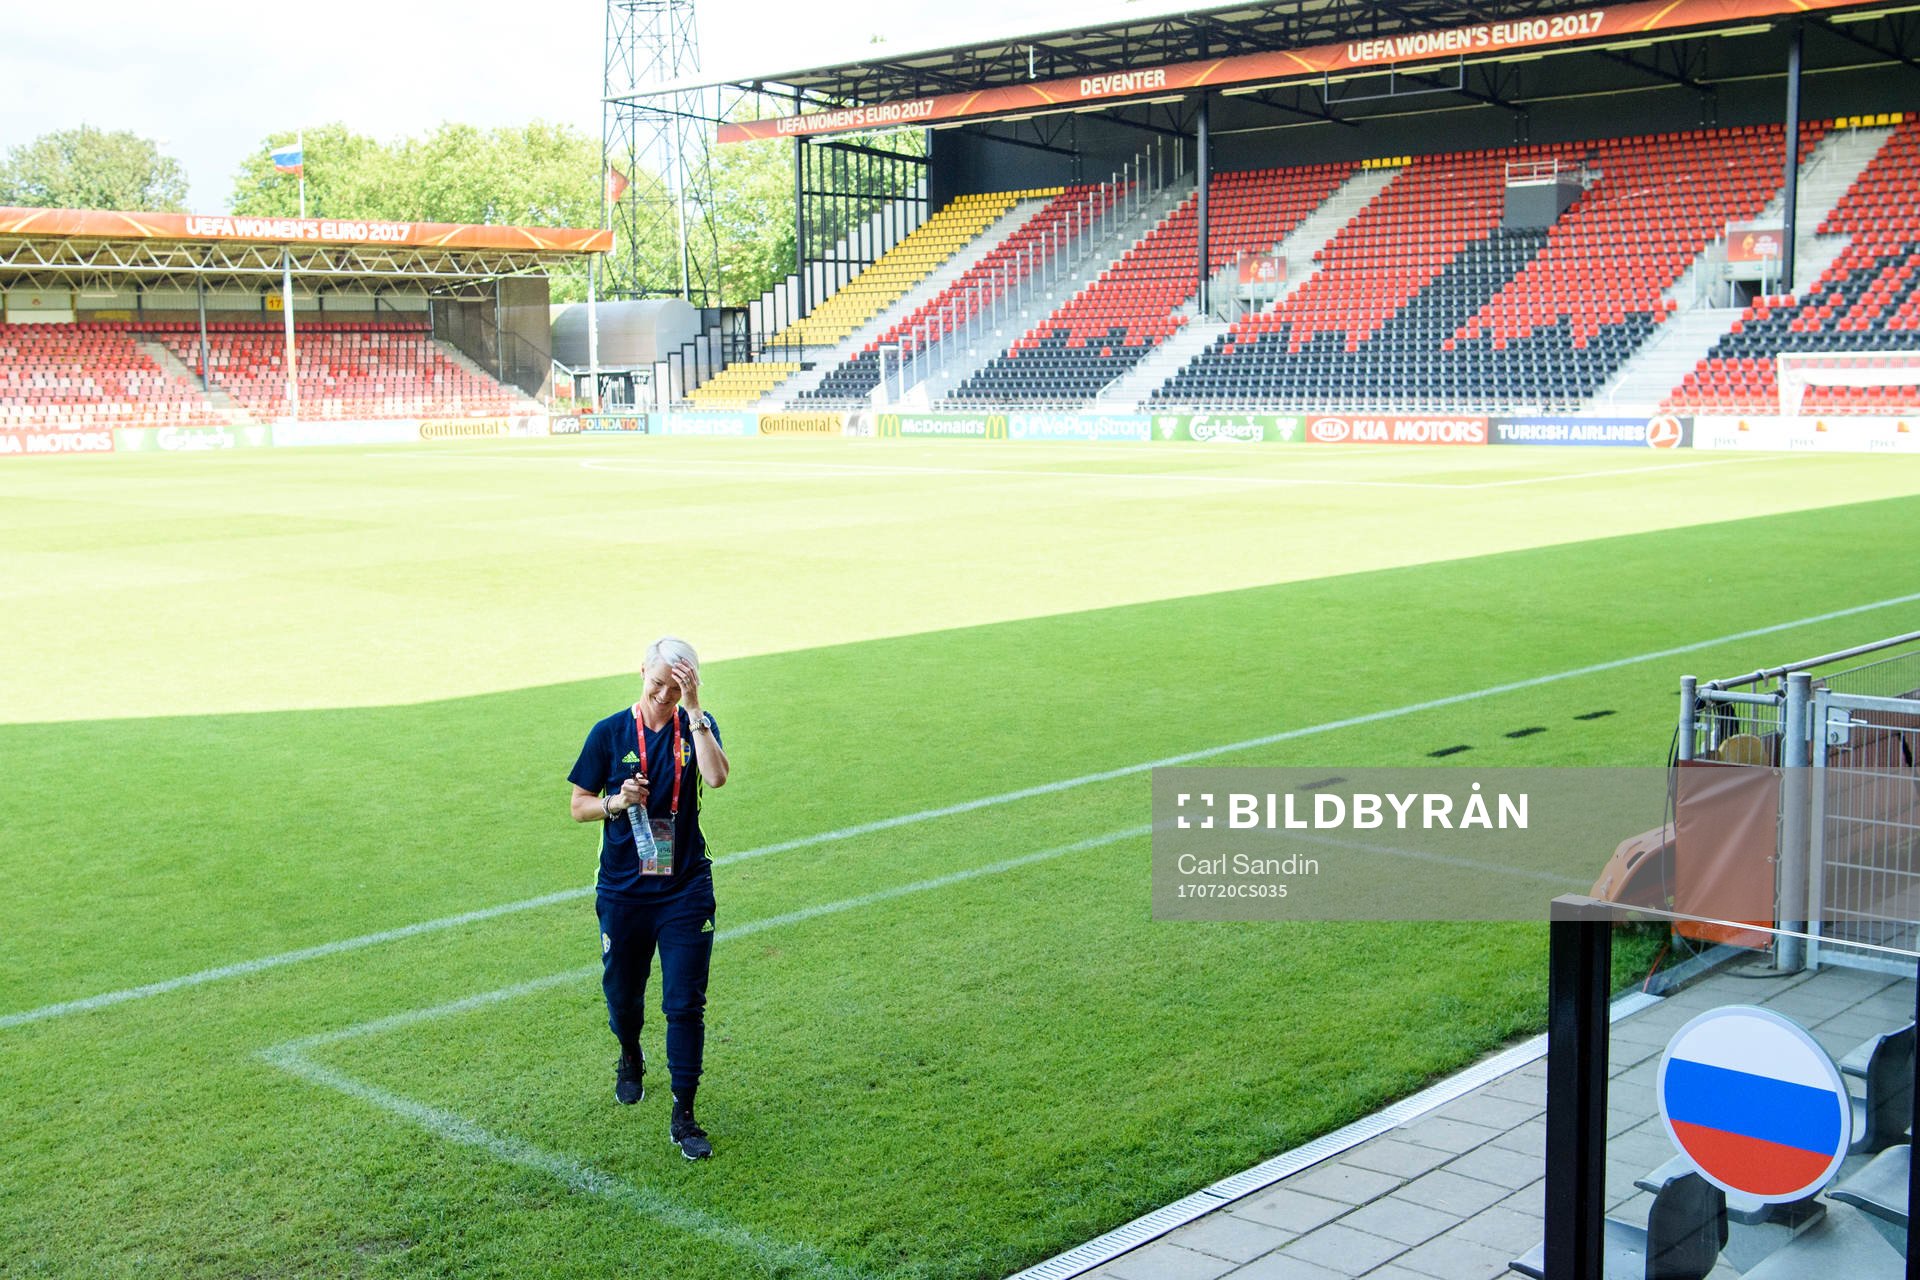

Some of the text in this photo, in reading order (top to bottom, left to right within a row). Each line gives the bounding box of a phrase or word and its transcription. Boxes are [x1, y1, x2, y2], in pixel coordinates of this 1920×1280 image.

[1348, 12, 1604, 63] UEFA WOMEN'S EURO 2017
[1080, 69, 1166, 96] DEVENTER
[776, 100, 934, 134] UEFA WOMEN'S EURO 2017
[185, 217, 410, 241] UEFA WOMEN'S EURO 2017
[419, 421, 498, 440] Continental
[552, 416, 645, 434] UEFA FOUNDATION
[662, 415, 744, 435] Hisense
[760, 415, 830, 436] Continental
[902, 415, 985, 434] McDonald's
[1189, 415, 1264, 441] Carlsberg
[1353, 421, 1483, 442] KIA MOTORS
[1498, 424, 1645, 441] TURKISH AIRLINES
[26, 432, 112, 452] MOTORS
